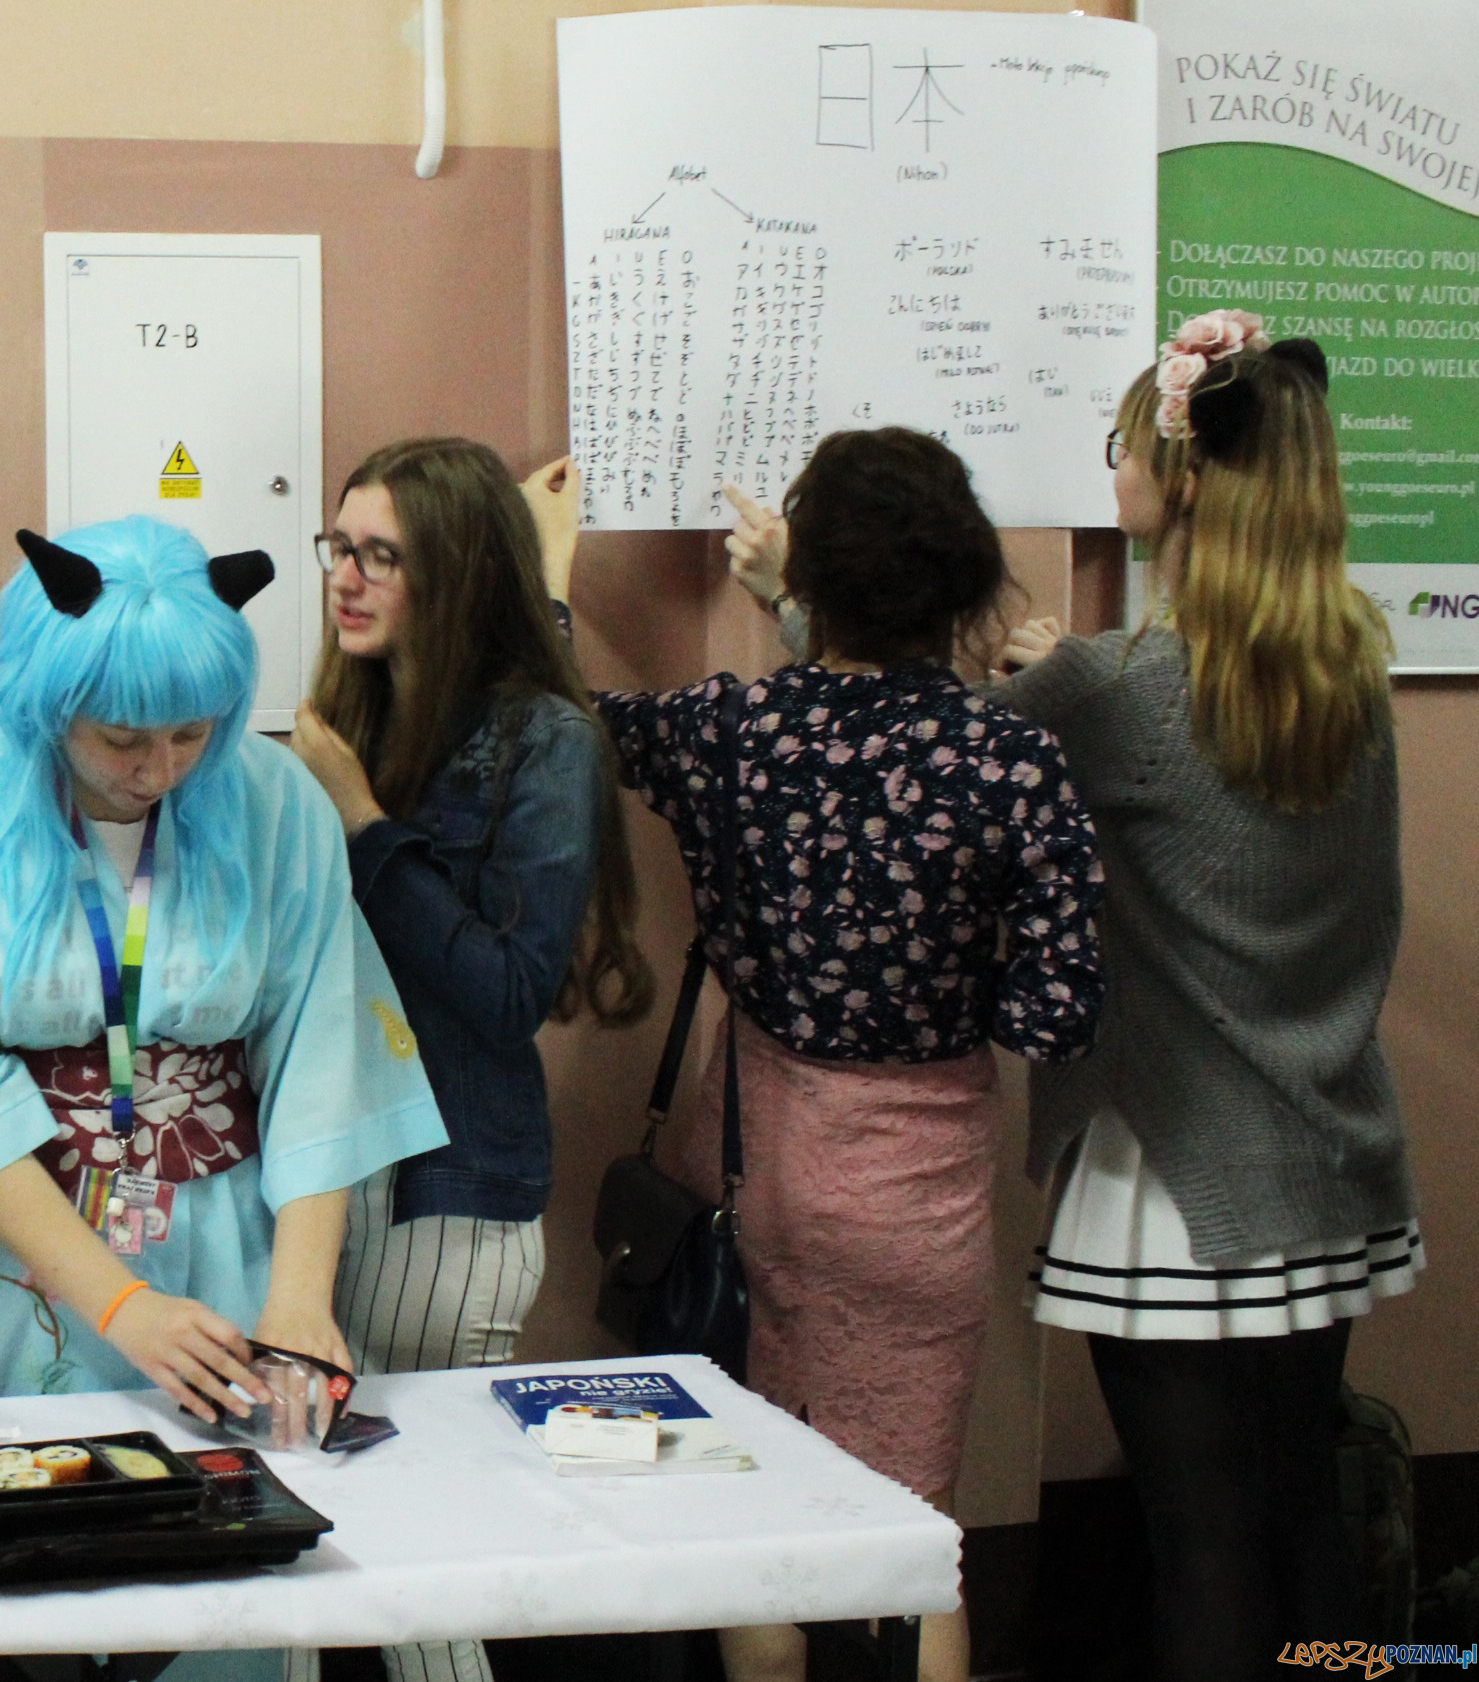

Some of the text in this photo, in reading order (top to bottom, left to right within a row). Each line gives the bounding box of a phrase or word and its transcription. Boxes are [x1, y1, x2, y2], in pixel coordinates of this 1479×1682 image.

[815, 43, 965, 152] 日本
[1177, 51, 1461, 146] POKAŻ SIĘ ŚWIATU
[1187, 97, 1196, 124] I
[1209, 93, 1315, 128] ZARÓB
[1325, 109, 1369, 147] NA
[603, 225, 671, 243] HIRAGANA
[754, 218, 818, 234] KATAKANA
[1039, 236, 1124, 260] すみません
[1295, 247, 1325, 266] DO
[1332, 248, 1425, 270] NASZEGO
[1315, 282, 1389, 303] POMOC
[1394, 285, 1416, 303] W
[888, 294, 961, 315] こんにちは
[1282, 317, 1354, 342] SZANSĘ
[1360, 319, 1389, 338] NA
[1383, 358, 1415, 377] DO
[1340, 413, 1413, 431] Kontakt:
[516, 1377, 669, 1394] JAPOŃSKI
